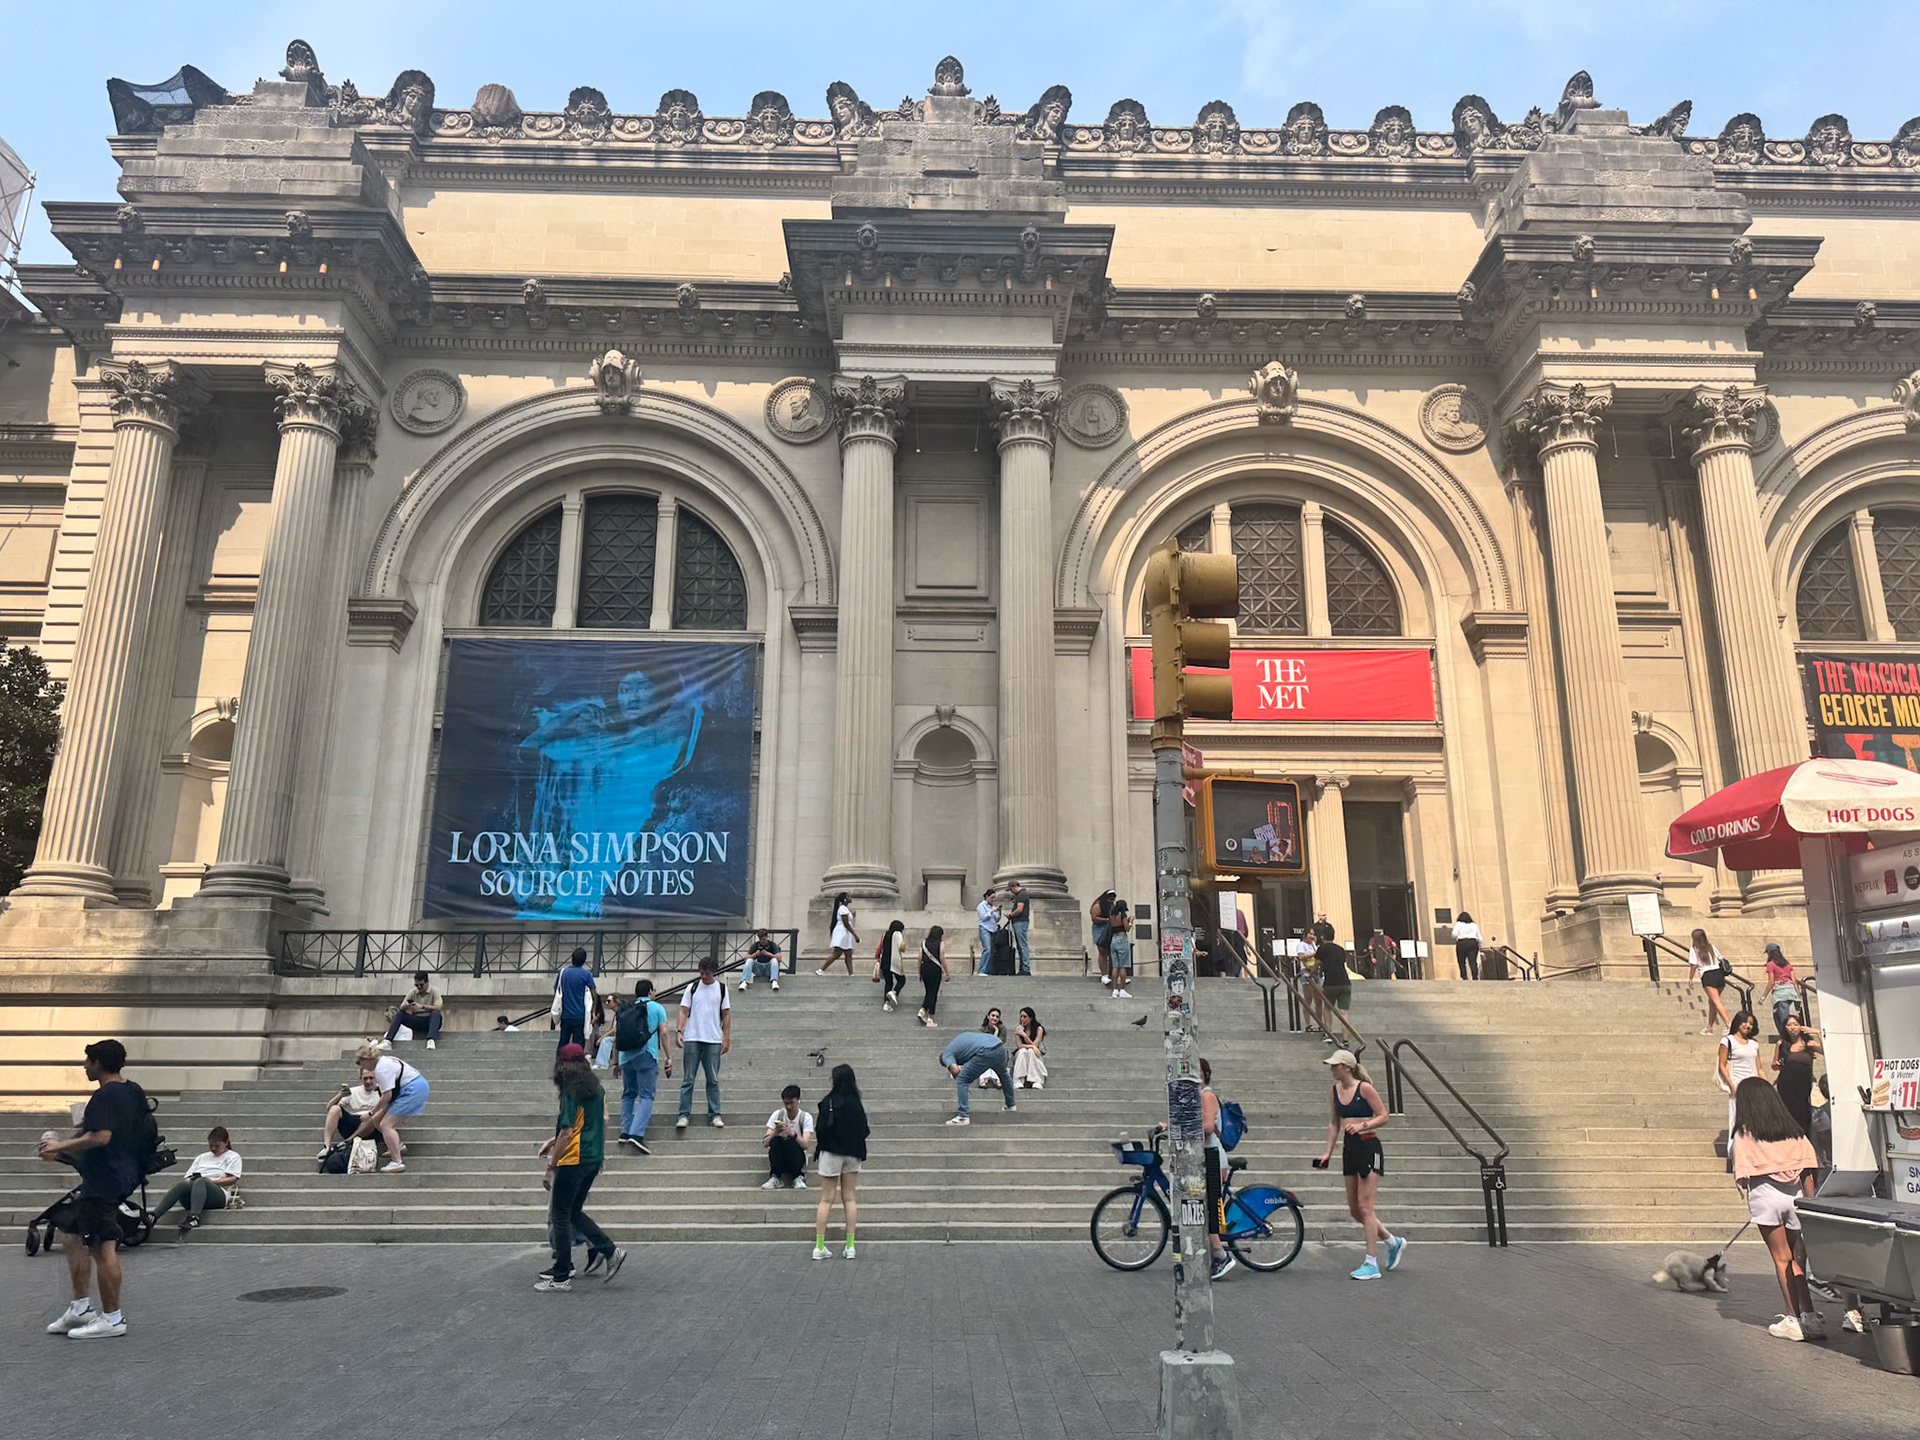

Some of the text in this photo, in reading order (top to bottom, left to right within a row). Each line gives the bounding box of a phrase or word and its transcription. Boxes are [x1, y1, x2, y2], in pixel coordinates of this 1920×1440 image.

[1256, 659, 1307, 683] THE
[1813, 661, 1920, 694] THE MAGICA
[1257, 685, 1309, 709] MET
[1819, 694, 1920, 727] GEORGE MO
[1827, 807, 1915, 824] HOT DOGS
[1690, 815, 1761, 846] COLD DRINKS
[448, 831, 731, 864] LORNA SIMPSON
[1903, 849, 1912, 859] AS
[480, 869, 695, 897] SOURCE NOTES
[1854, 879, 1880, 893] NETFLIX
[1875, 1059, 1920, 1079] 2 HOT DOGS
[1897, 1071, 1914, 1079] Water
[1182, 1203, 1205, 1225] DAZES
